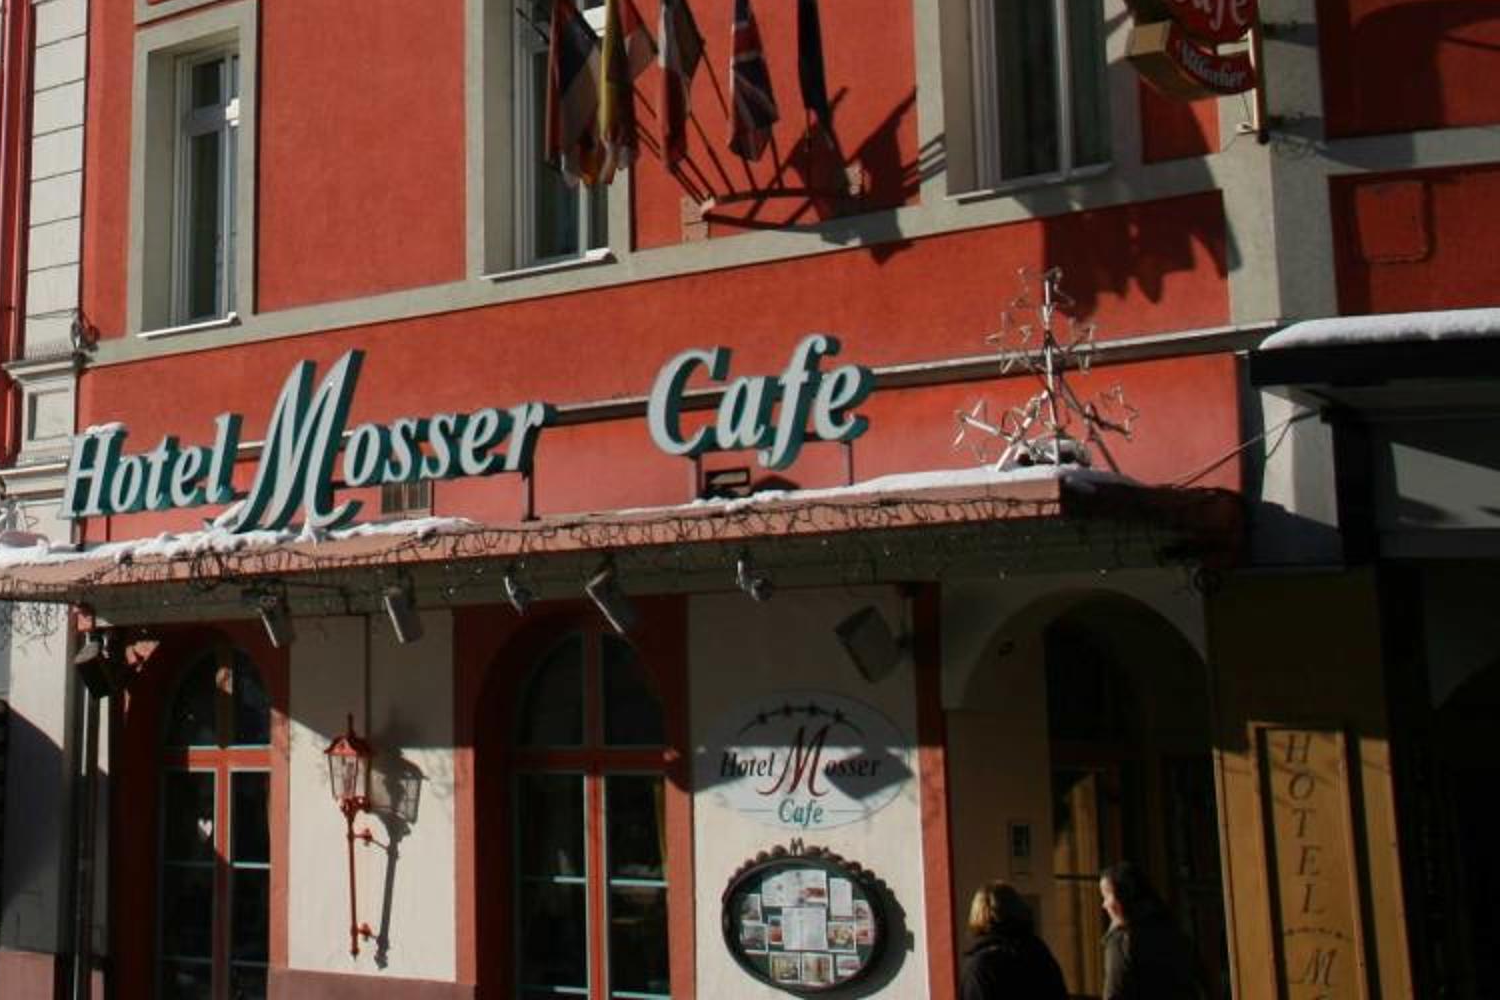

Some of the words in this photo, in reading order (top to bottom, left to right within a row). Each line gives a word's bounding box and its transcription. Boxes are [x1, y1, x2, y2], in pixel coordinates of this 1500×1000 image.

[57, 411, 241, 519] Hotel
[234, 349, 556, 533] Mosser
[646, 333, 874, 471] Cafe
[720, 751, 775, 777] Hotel
[757, 723, 882, 797] Mosser
[778, 798, 824, 827] Cafe
[1285, 733, 1325, 916] HOTEL
